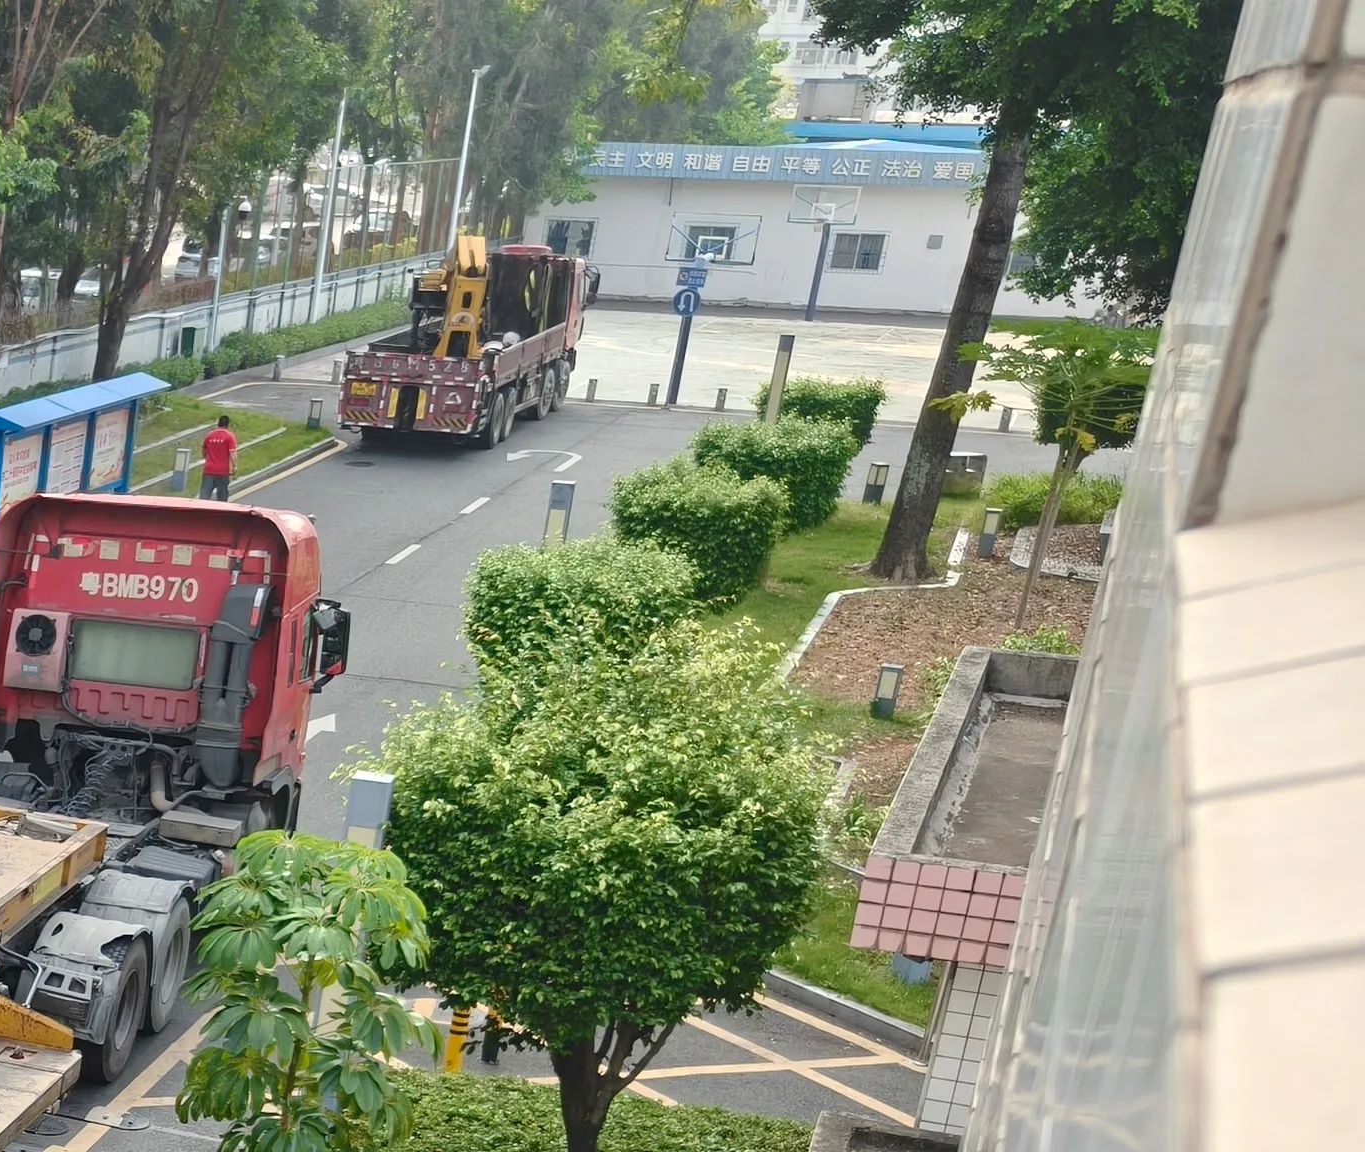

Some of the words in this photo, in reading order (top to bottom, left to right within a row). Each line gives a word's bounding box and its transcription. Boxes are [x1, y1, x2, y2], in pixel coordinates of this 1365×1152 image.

[635, 151, 674, 169] 文明
[684, 152, 723, 171] 和谐
[732, 155, 770, 173] 自由
[781, 156, 821, 175] 平等
[831, 157, 872, 177] 公正
[881, 159, 922, 179] 法治
[932, 161, 974, 181] 爱国
[80, 571, 199, 603] 粤BMB970
